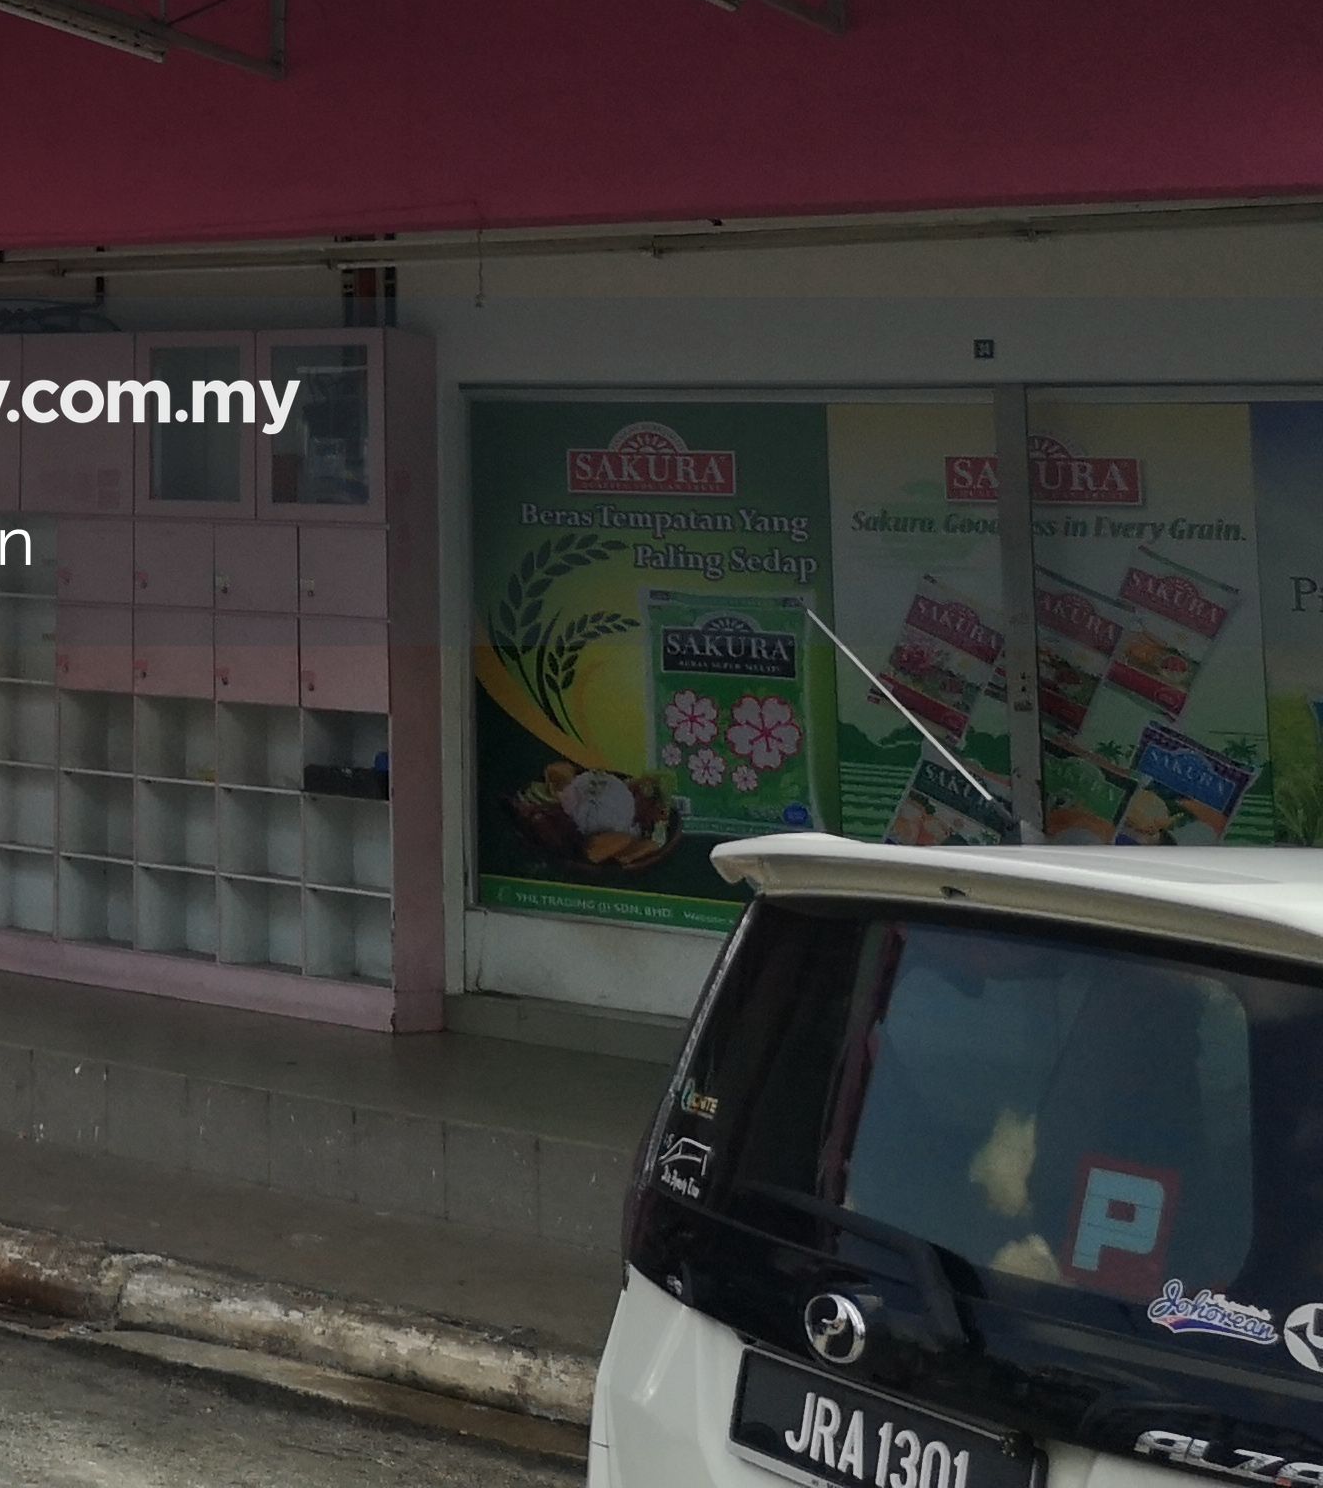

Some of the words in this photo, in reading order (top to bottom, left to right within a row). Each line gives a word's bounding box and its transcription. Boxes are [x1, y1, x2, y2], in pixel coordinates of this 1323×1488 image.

[575, 454, 726, 484] SAKURA
[953, 459, 1129, 492] SAURA
[520, 503, 592, 527] Beras
[595, 503, 733, 539] Tempatan
[738, 509, 809, 543] Yang
[1065, 514, 1088, 538] in
[1093, 514, 1164, 546] Every
[1169, 516, 1247, 542] Grain.
[634, 544, 723, 580] Paling
[729, 547, 818, 584] Sedap
[666, 632, 790, 662] SAKURA
[1072, 1166, 1166, 1272] P
[784, 1392, 864, 1480] JRA
[875, 1421, 970, 1488] 1301
